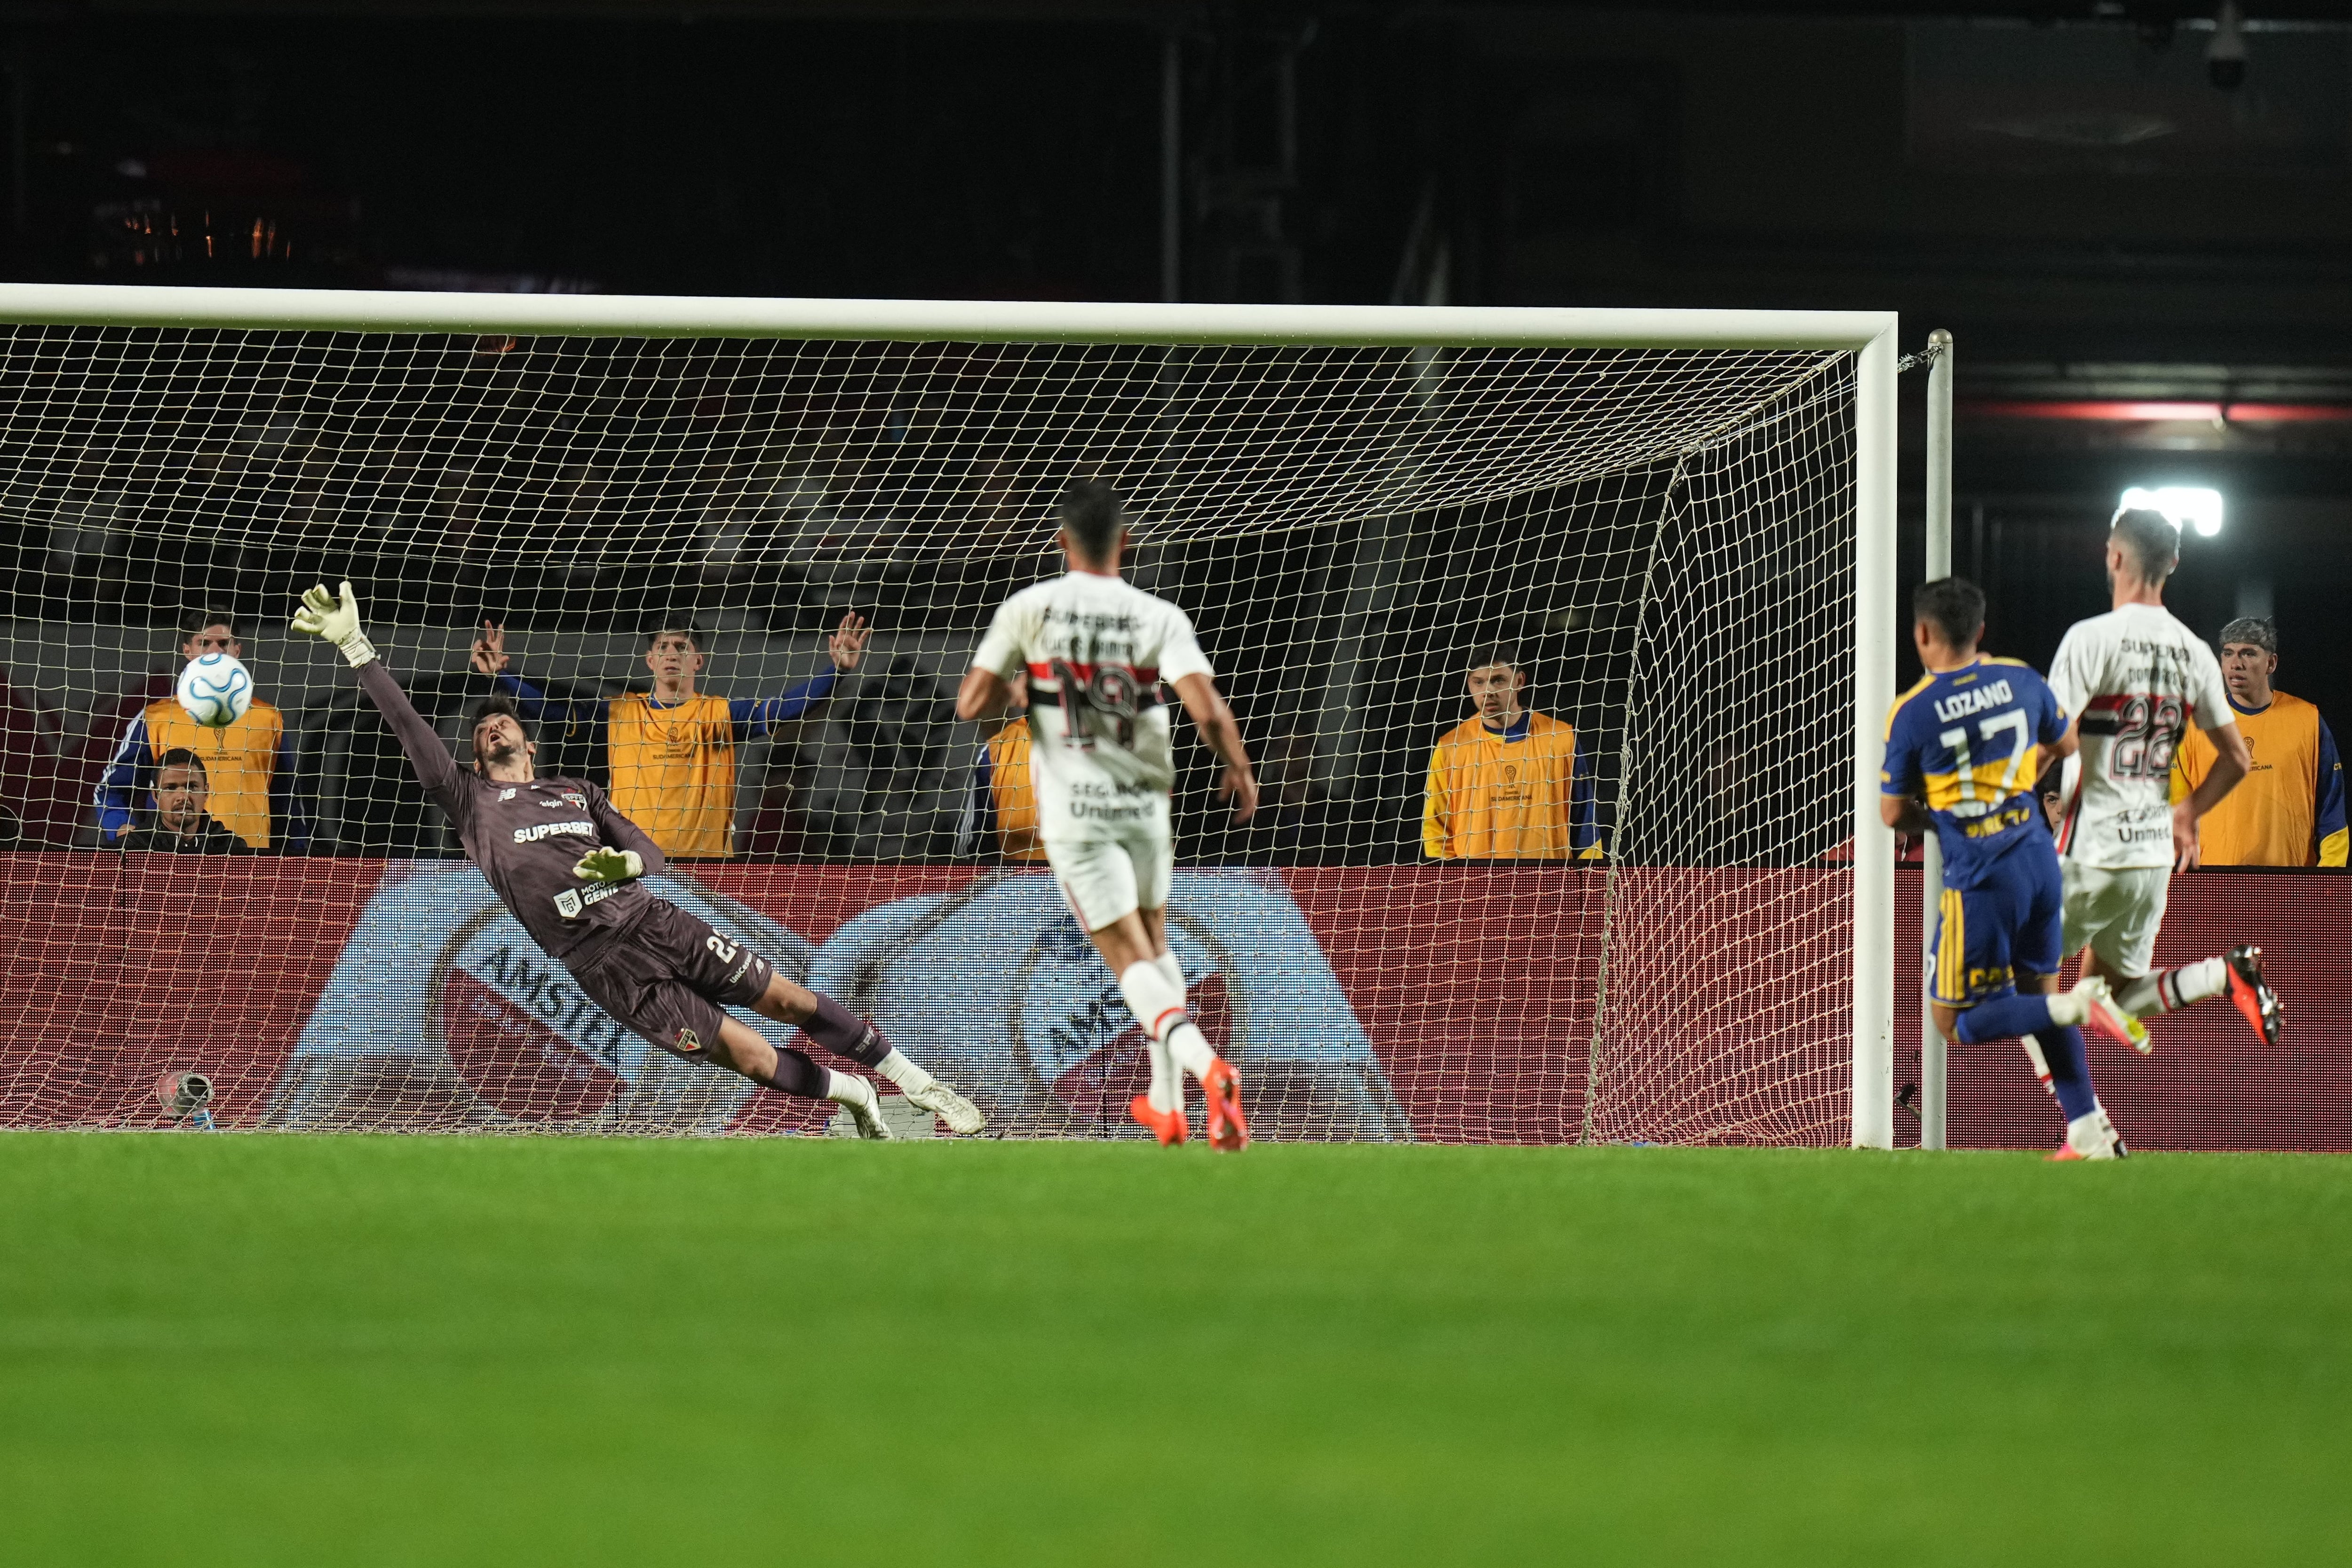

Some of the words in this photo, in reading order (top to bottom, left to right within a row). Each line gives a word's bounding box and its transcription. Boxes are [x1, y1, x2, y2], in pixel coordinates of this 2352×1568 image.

[1047, 658, 1138, 750] 19
[1934, 678, 2013, 723] LOZANO
[1939, 707, 2029, 818] 17
[2109, 693, 2182, 783] 22
[513, 821, 594, 844] SUPERBET
[580, 881, 606, 896] MOTO
[477, 944, 627, 1065] AMSTEL
[855, 1026, 875, 1053] SPF
